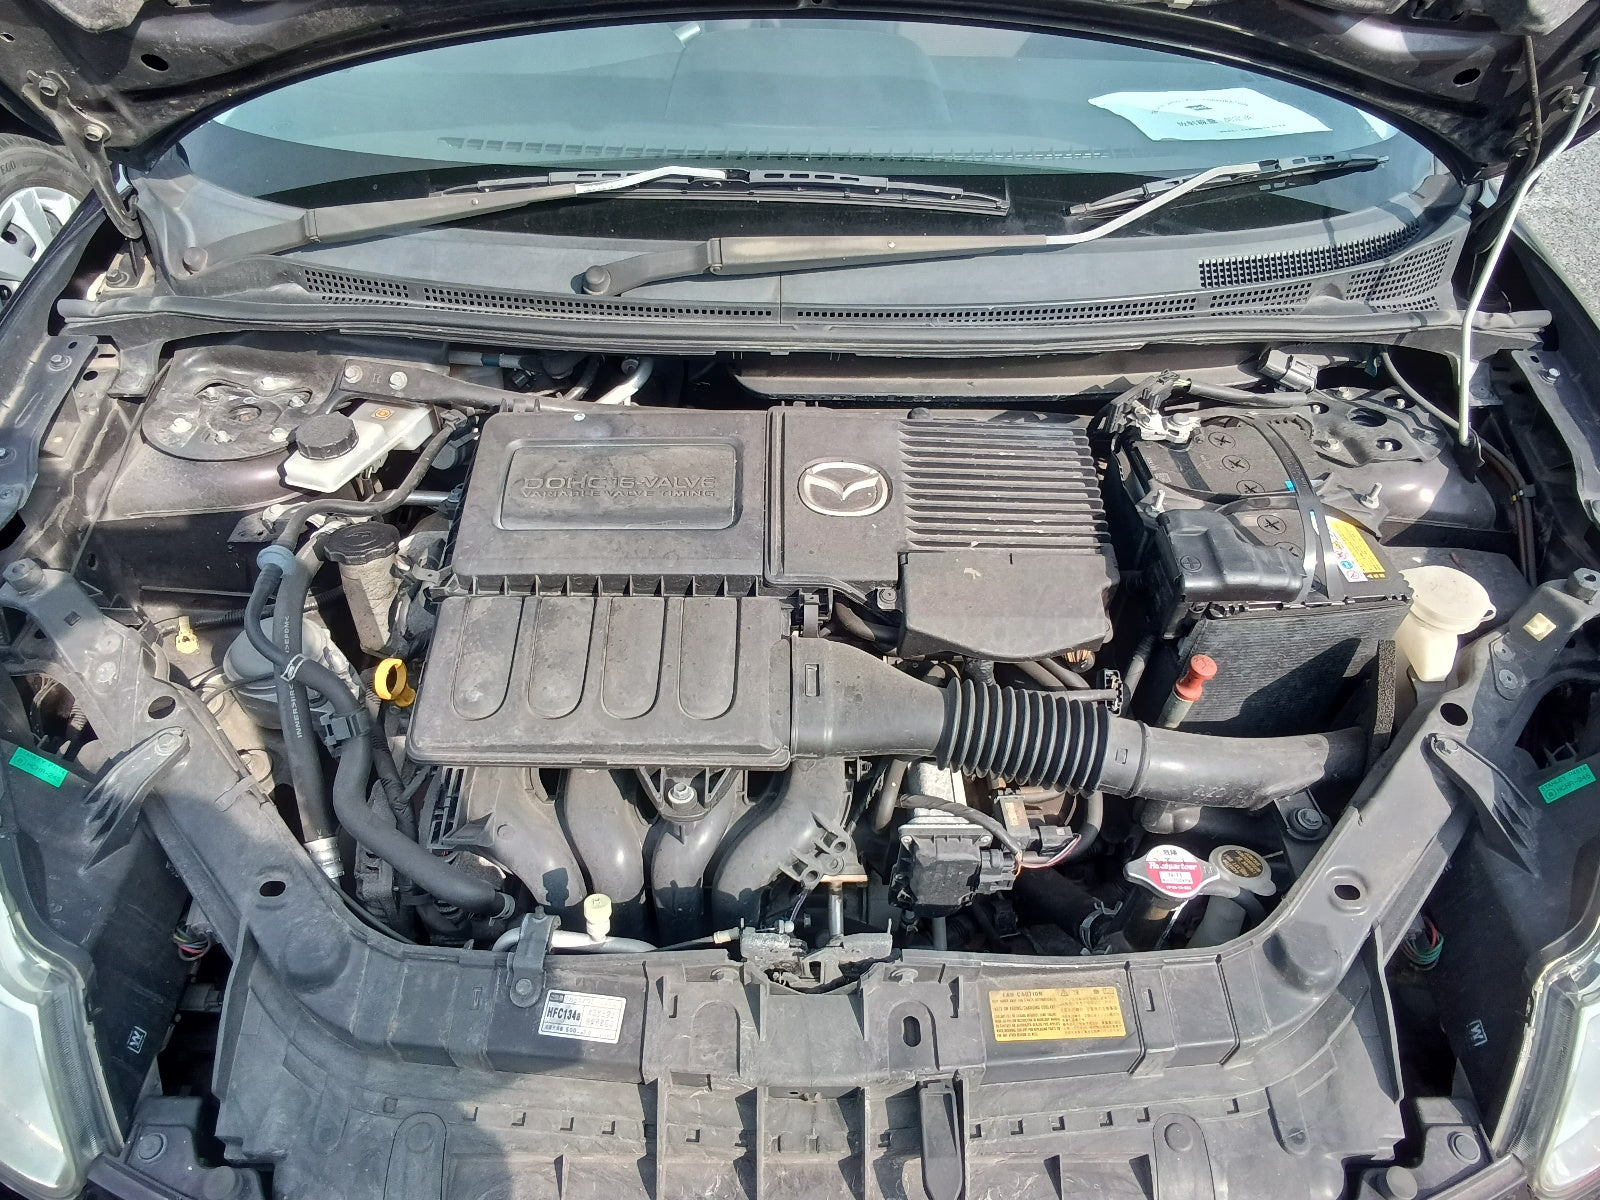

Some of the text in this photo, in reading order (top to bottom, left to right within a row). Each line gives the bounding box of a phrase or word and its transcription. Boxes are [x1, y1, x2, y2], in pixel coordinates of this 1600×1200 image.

[523, 475, 717, 489] DOHC 16-VALVE
[521, 490, 600, 498] VARIABLE
[546, 1006, 582, 1021] HFC134a
